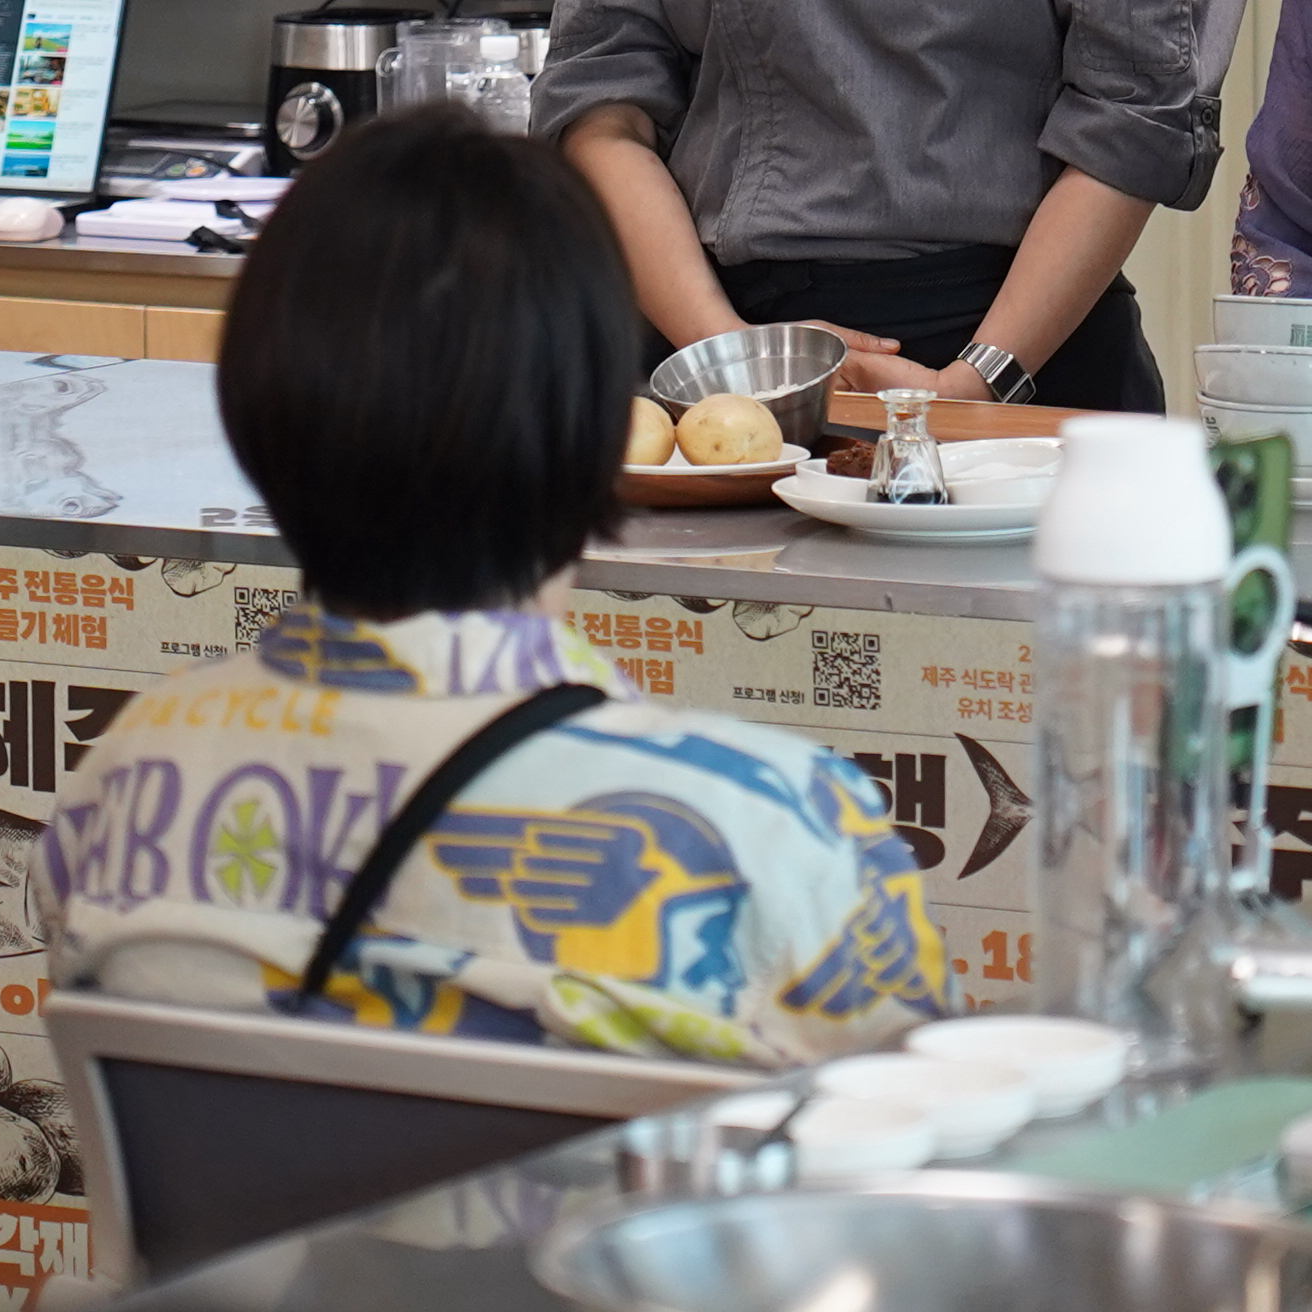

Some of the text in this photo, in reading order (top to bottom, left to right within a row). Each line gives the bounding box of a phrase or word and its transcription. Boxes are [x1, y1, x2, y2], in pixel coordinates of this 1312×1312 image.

[23, 570, 135, 611] 전통음식
[52, 613, 108, 650] 체험
[583, 613, 704, 655] 전통음식
[160, 641, 200, 657] 프로그램
[921, 665, 957, 688] 제주
[961, 669, 1015, 694] 식도락
[732, 687, 776, 702] 프로그램
[957, 696, 1033, 723] 유치 조성
